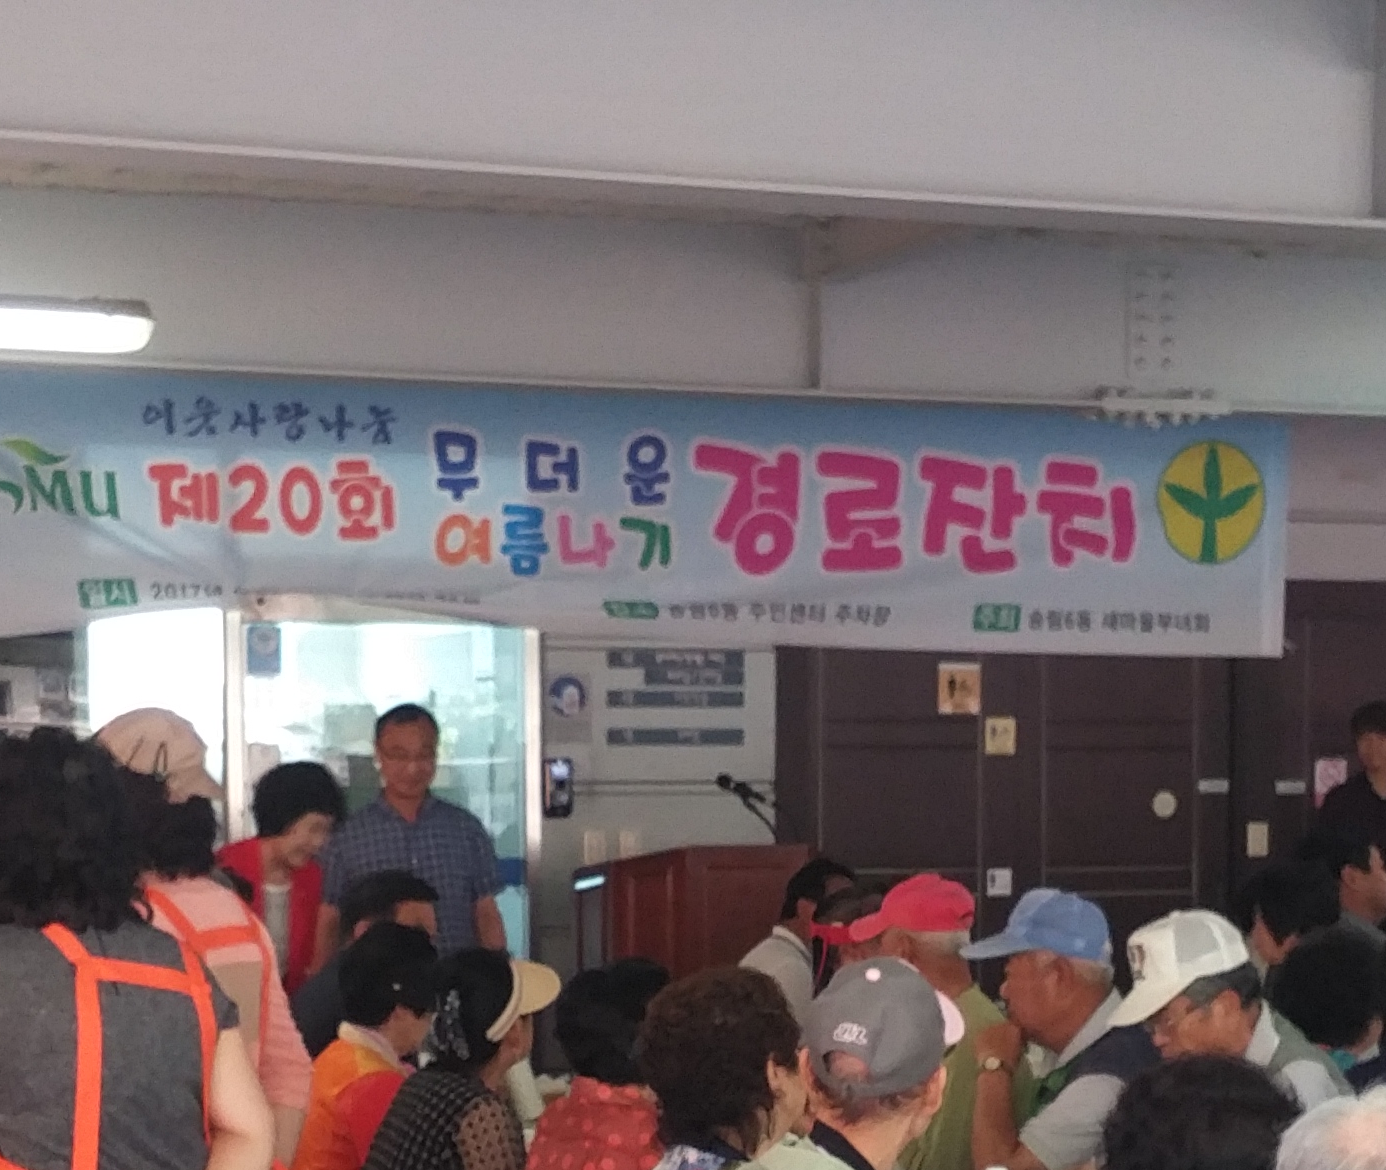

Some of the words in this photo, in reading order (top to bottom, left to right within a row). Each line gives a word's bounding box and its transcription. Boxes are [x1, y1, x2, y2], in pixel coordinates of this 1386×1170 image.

[146, 458, 396, 542] 제20회
[434, 503, 672, 577] 여름나기
[692, 441, 1136, 577] 경로잔치
